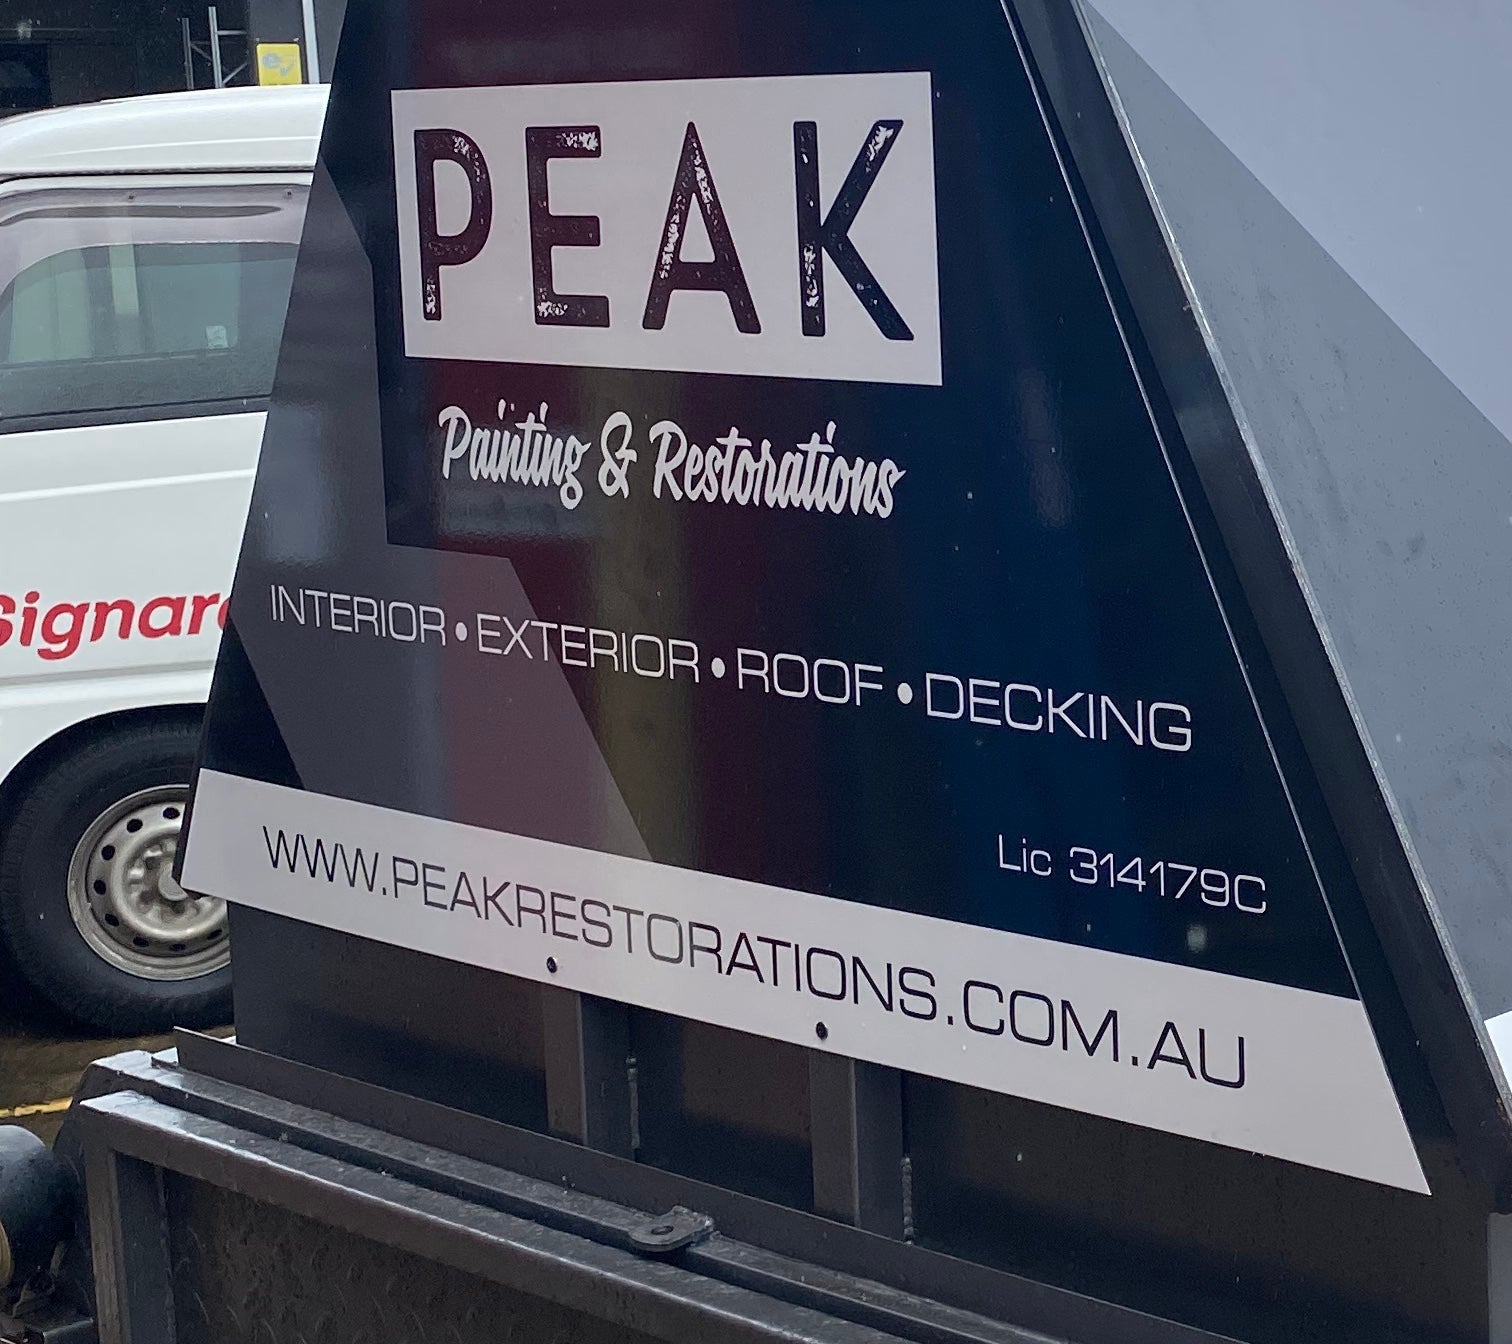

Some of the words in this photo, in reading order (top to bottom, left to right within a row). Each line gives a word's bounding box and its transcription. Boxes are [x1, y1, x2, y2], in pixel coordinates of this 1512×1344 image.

[413, 119, 915, 342] PEAK
[437, 398, 592, 510] Painting
[597, 411, 638, 499] &
[648, 420, 907, 519] Restorations
[270, 584, 446, 646] INTERIOR
[476, 613, 700, 683] EXTERIOR
[736, 647, 884, 706] ROOF
[925, 672, 1193, 752] DECKING
[261, 825, 1248, 1089] WWW.PEAKRESTORATIONS.COM.AU
[997, 834, 1052, 876] Lic
[1069, 846, 1267, 914] 314179C
